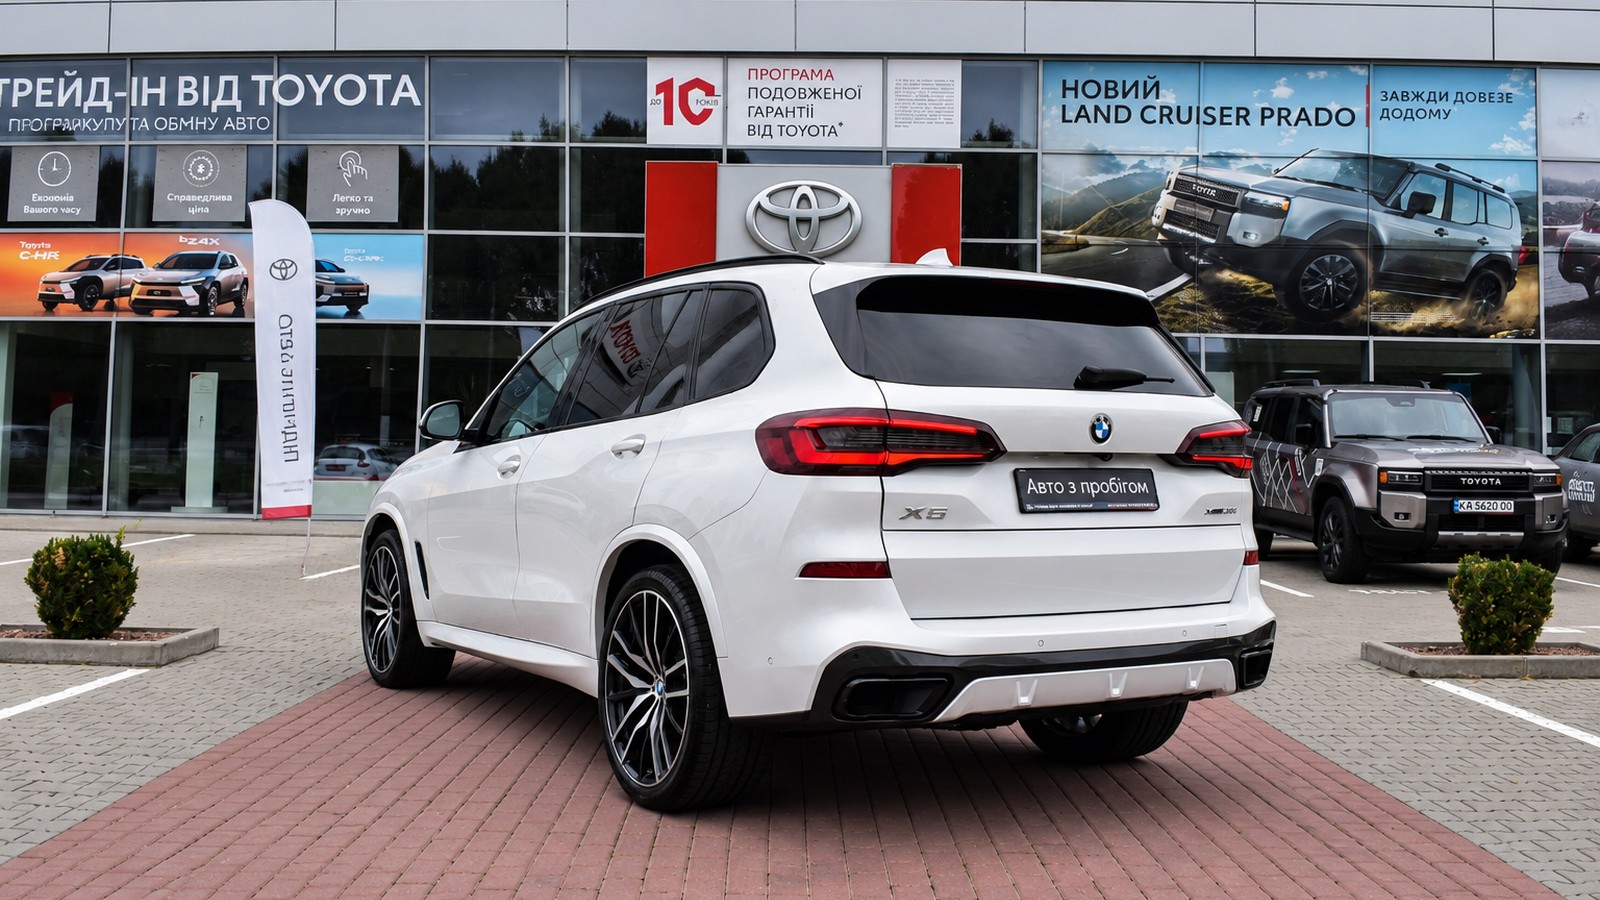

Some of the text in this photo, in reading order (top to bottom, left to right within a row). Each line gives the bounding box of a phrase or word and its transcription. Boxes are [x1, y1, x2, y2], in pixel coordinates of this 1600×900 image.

[747, 68, 834, 81] ПРОГРАМА
[177, 75, 242, 113] ВІД
[251, 73, 422, 107] TOYOTA
[747, 84, 863, 102] ПОДОВЖЕНОЇ
[1061, 74, 1160, 100] НОВИЙ
[1380, 90, 1513, 105] ЗАВЖДИ ДОВЕЗЕ
[1061, 104, 1356, 127] LAND CRUISER PRADO
[1379, 107, 1452, 121] ДОДОМУ
[130, 117, 150, 131] ТА
[223, 116, 271, 131] АВТО
[747, 124, 773, 139] ВІД
[1027, 476, 1149, 498] Авто з пробігом
[1460, 477, 1502, 486] TOYOTA
